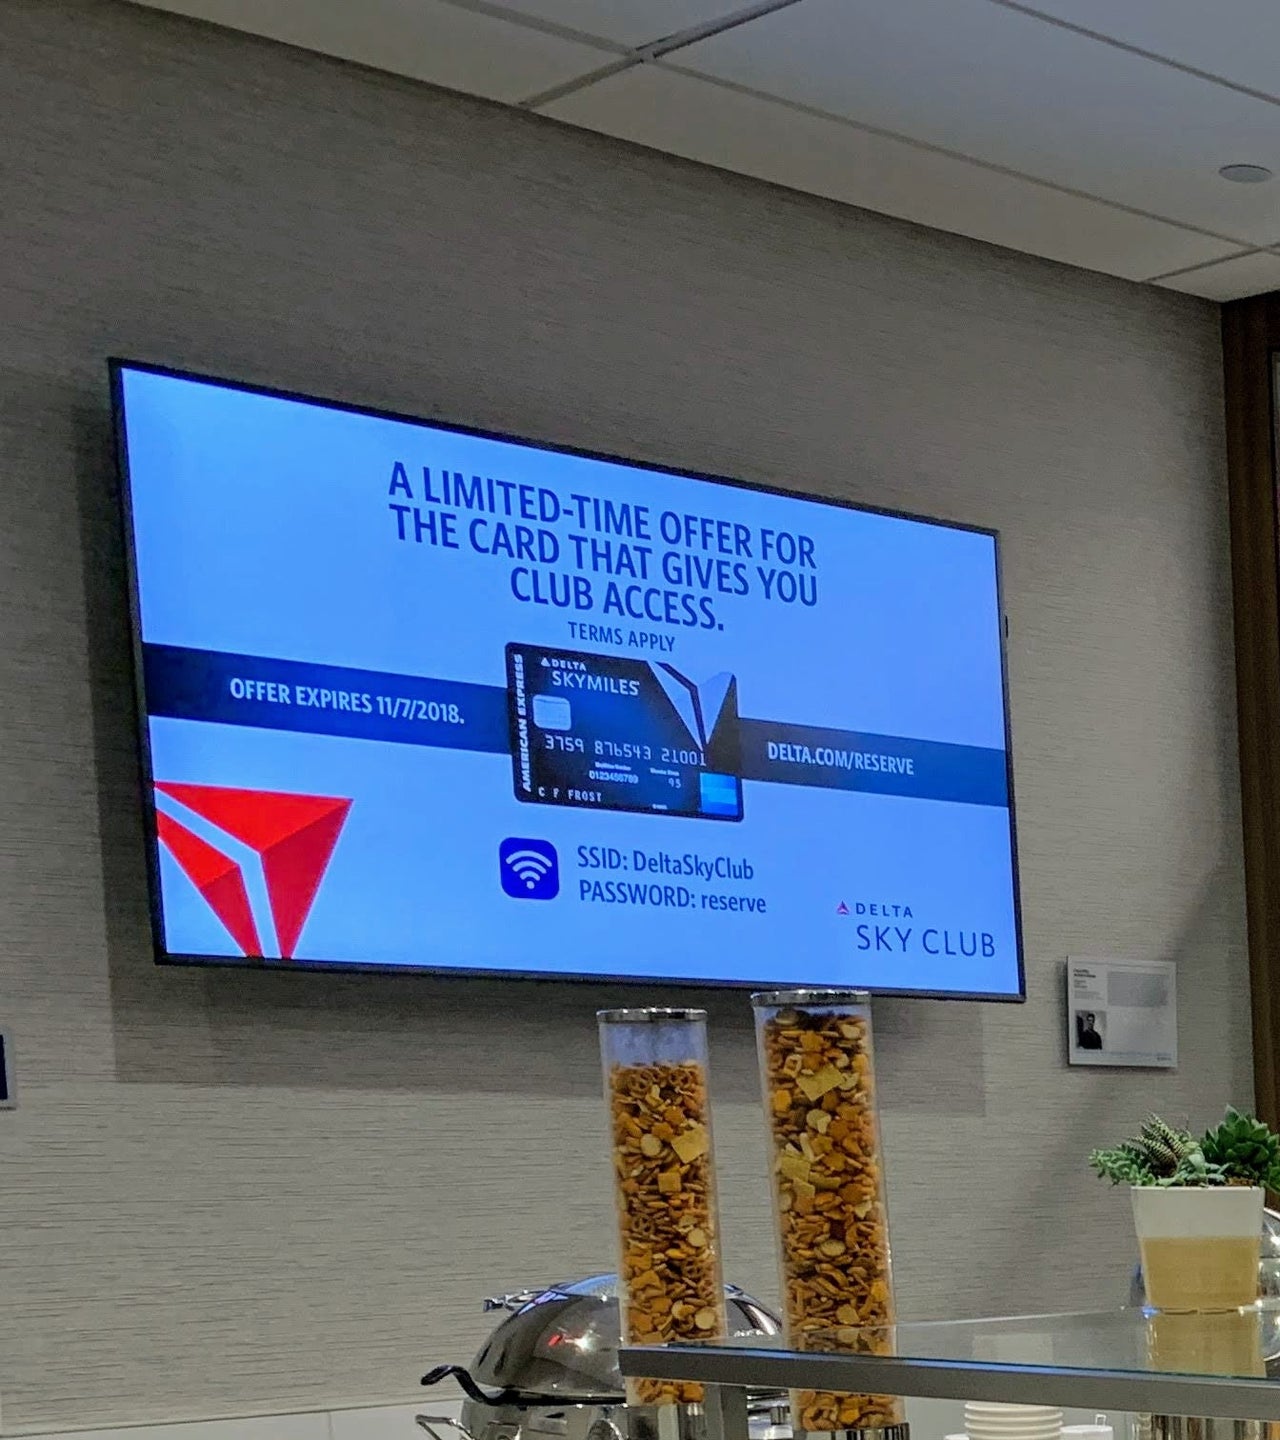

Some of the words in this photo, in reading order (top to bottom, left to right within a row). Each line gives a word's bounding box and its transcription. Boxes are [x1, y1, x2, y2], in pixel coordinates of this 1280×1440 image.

[388, 460, 413, 499] A
[423, 466, 651, 540] LIMITED-TIME
[660, 511, 753, 559] OFFER
[760, 528, 818, 569] FOR
[388, 503, 460, 550] THE
[469, 519, 560, 564] CARD
[568, 534, 653, 580] THAT
[661, 551, 750, 597] GIVES
[756, 566, 818, 606] YOU
[511, 567, 594, 612] CLUB
[603, 581, 725, 631] ACCESS.
[567, 621, 624, 645] TERMS
[628, 631, 676, 652] APPLY
[552, 660, 587, 672] DELTA
[230, 677, 292, 705] OFFER
[296, 686, 373, 714] EXPIRES
[376, 695, 465, 725] 11/7/2018.
[513, 653, 527, 717] EXPRESS
[517, 718, 532, 793] AMERICAN
[545, 734, 585, 754] 3759
[594, 743, 652, 761] 876543
[661, 748, 707, 767] 21001
[767, 741, 915, 776] DELTA.COM/RESERVE
[567, 789, 602, 803] FROST
[577, 845, 628, 871] SSID:
[633, 851, 754, 881] DeltaSkyClub
[579, 879, 697, 909] PASSWORD:
[701, 892, 767, 914] reserve
[855, 902, 914, 920] DELTA
[856, 925, 912, 953] SKY
[922, 928, 996, 958] CLUB
